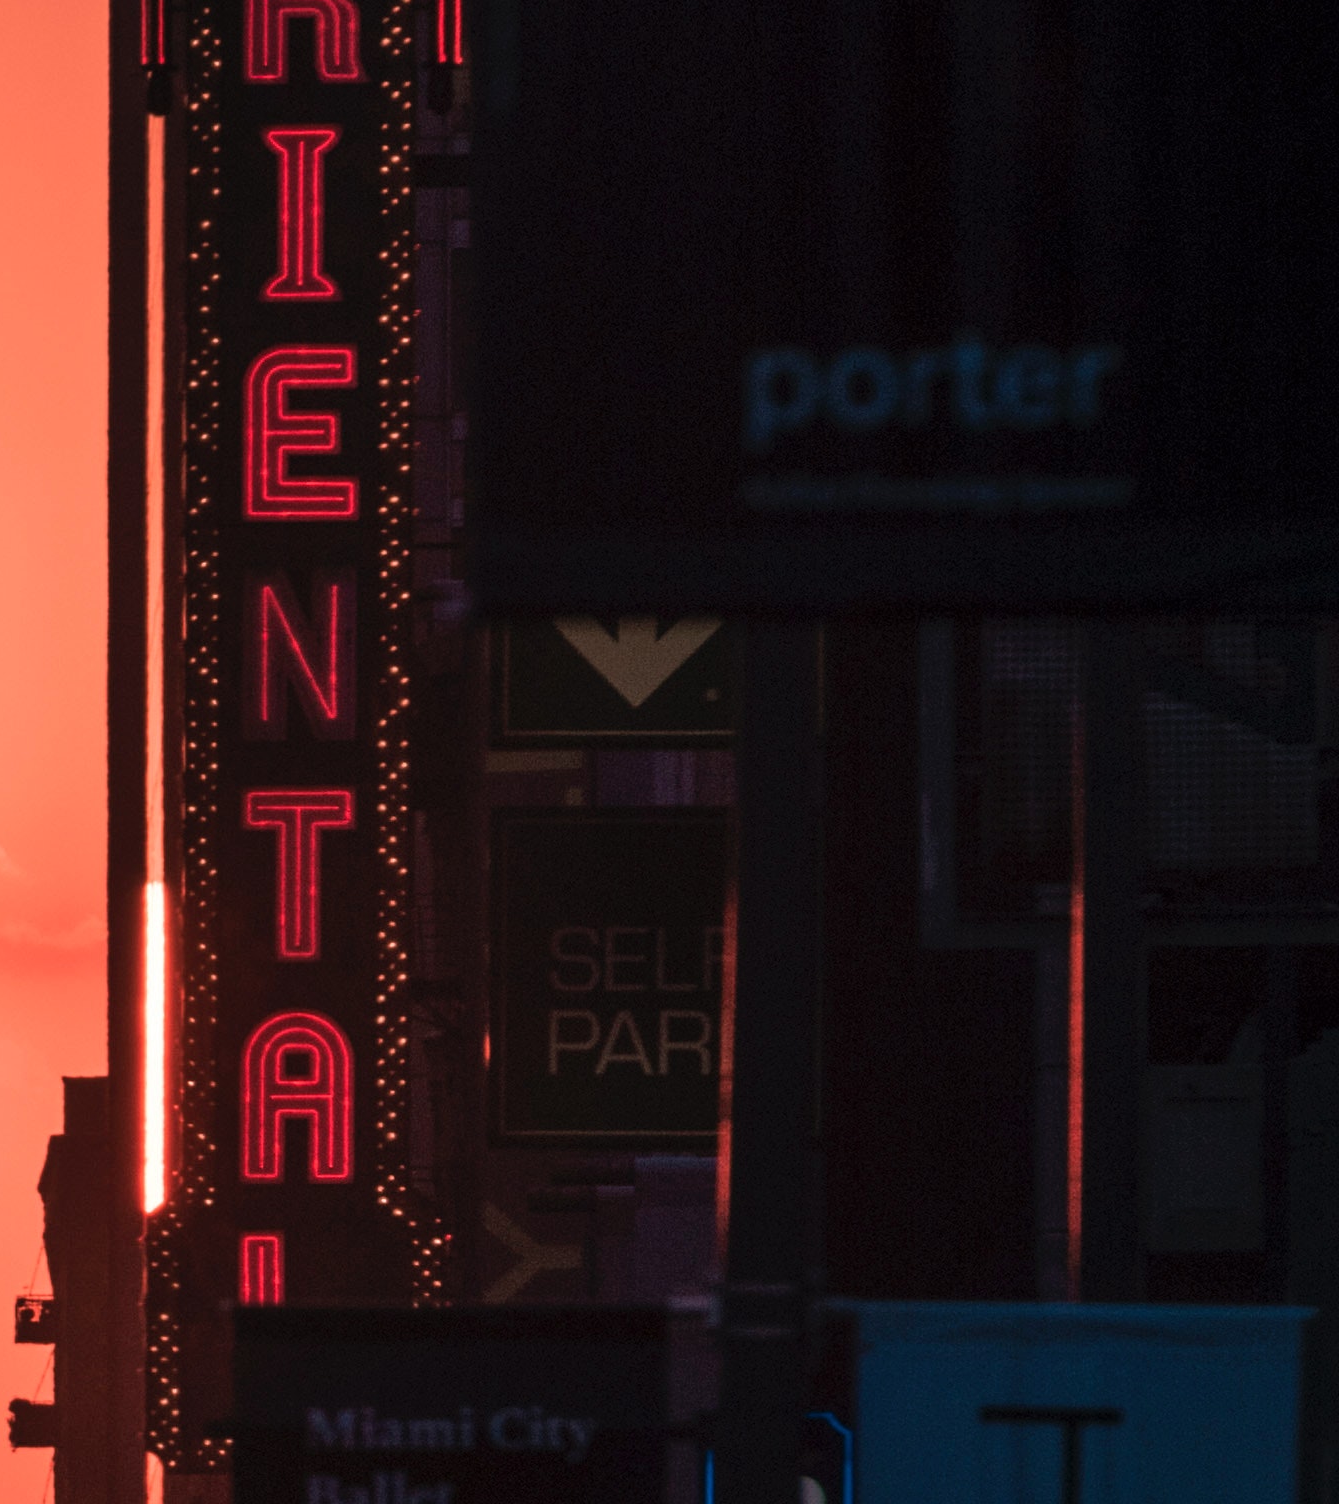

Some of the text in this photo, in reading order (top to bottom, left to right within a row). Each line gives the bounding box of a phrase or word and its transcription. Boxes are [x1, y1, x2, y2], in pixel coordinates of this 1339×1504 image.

[743, 330, 1121, 452] porter
[548, 1009, 713, 1076] PAR
[307, 1404, 596, 1464] Miami City
